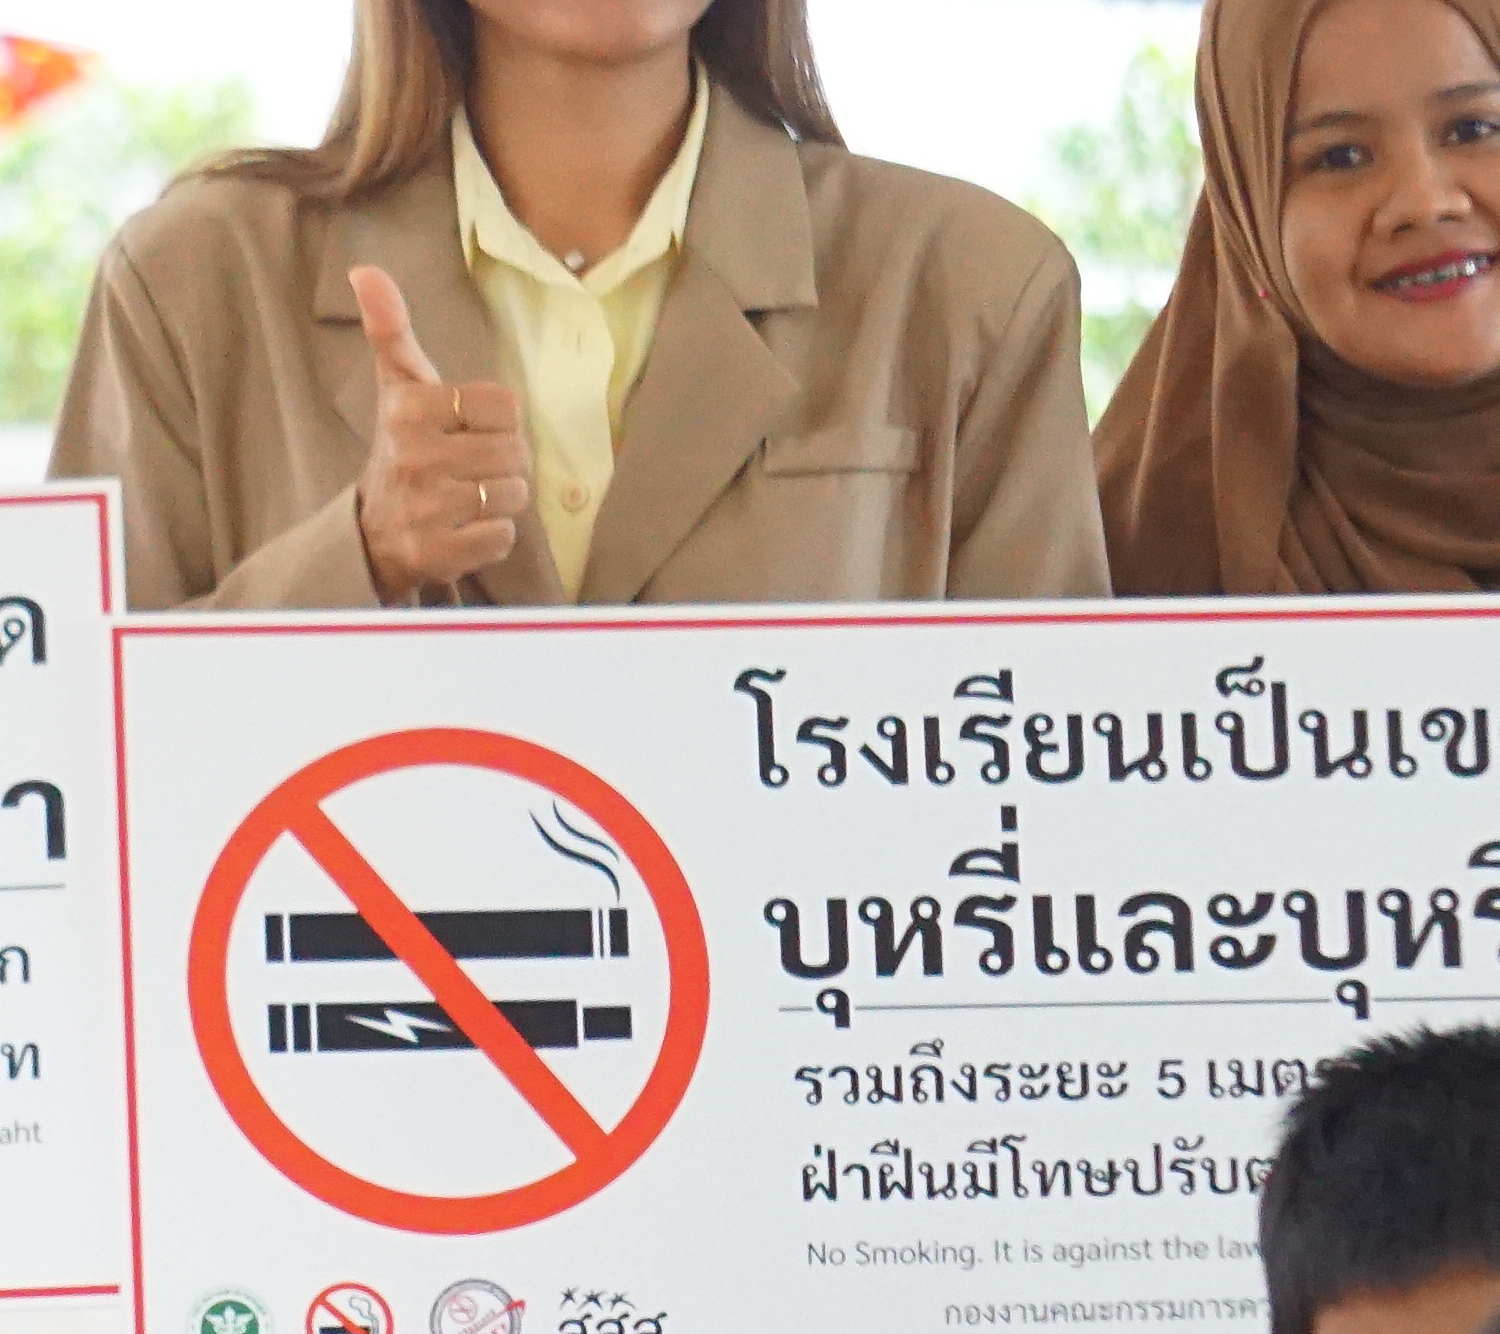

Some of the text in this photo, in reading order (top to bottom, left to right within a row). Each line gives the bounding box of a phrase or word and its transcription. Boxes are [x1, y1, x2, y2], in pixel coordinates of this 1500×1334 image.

[795, 1038, 1324, 1106] รวมถึงระยะ 5 เมต
[807, 1241, 847, 1267] No
[855, 1239, 983, 1272] Smoking.
[993, 1239, 1014, 1264] It
[1022, 1239, 1044, 1264] is
[1052, 1237, 1153, 1269] against
[1161, 1234, 1210, 1261] the
